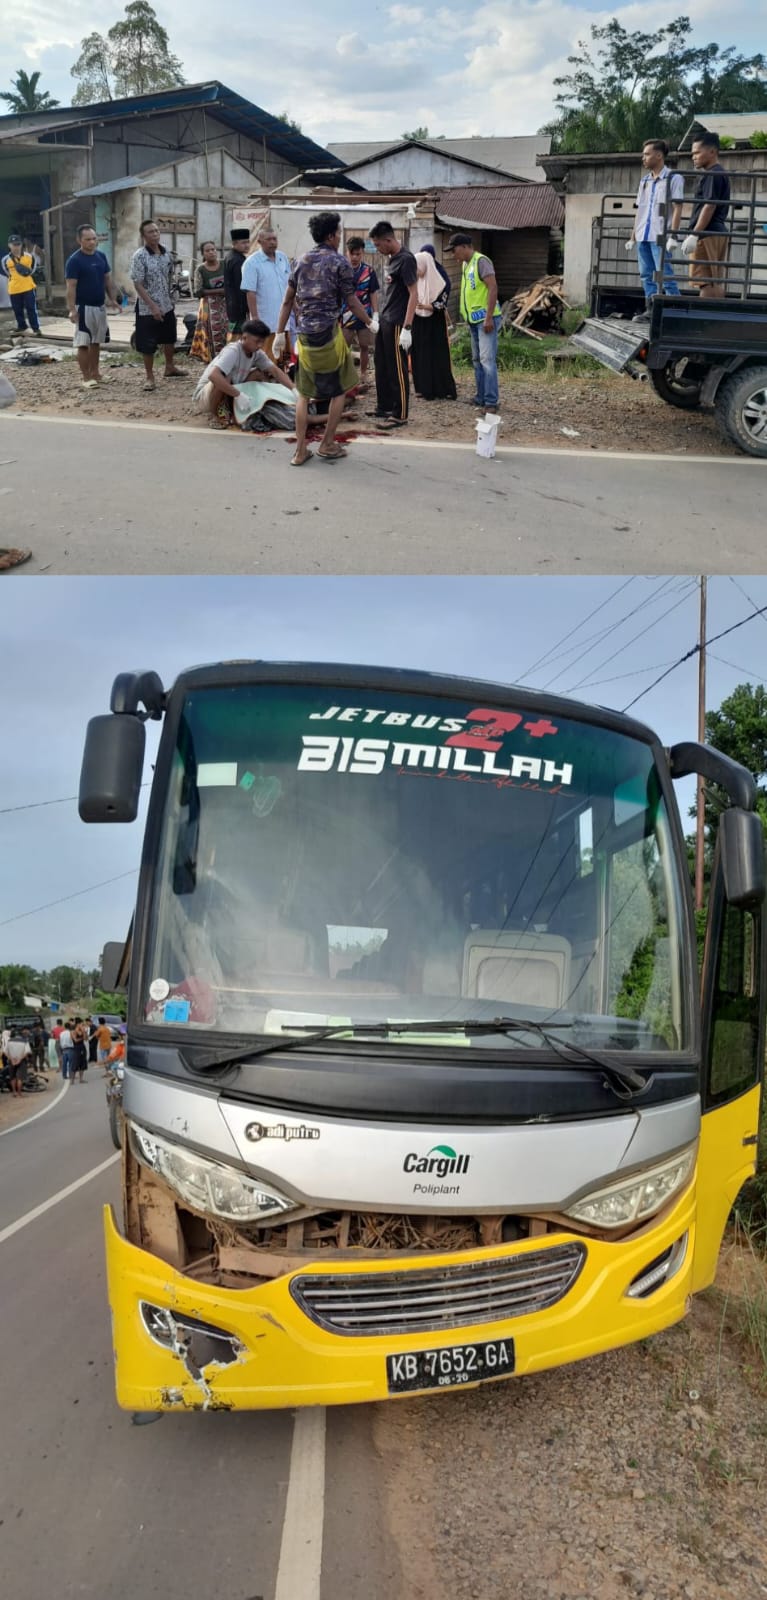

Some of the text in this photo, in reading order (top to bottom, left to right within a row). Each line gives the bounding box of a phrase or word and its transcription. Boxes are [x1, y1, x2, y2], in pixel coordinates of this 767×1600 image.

[309, 706, 468, 732] JETBUS
[297, 736, 573, 785] BISMILLAH
[403, 1153, 470, 1178] Cargill
[413, 1183, 460, 1196] Poliplant
[391, 1342, 509, 1381] KB 7652 GA
